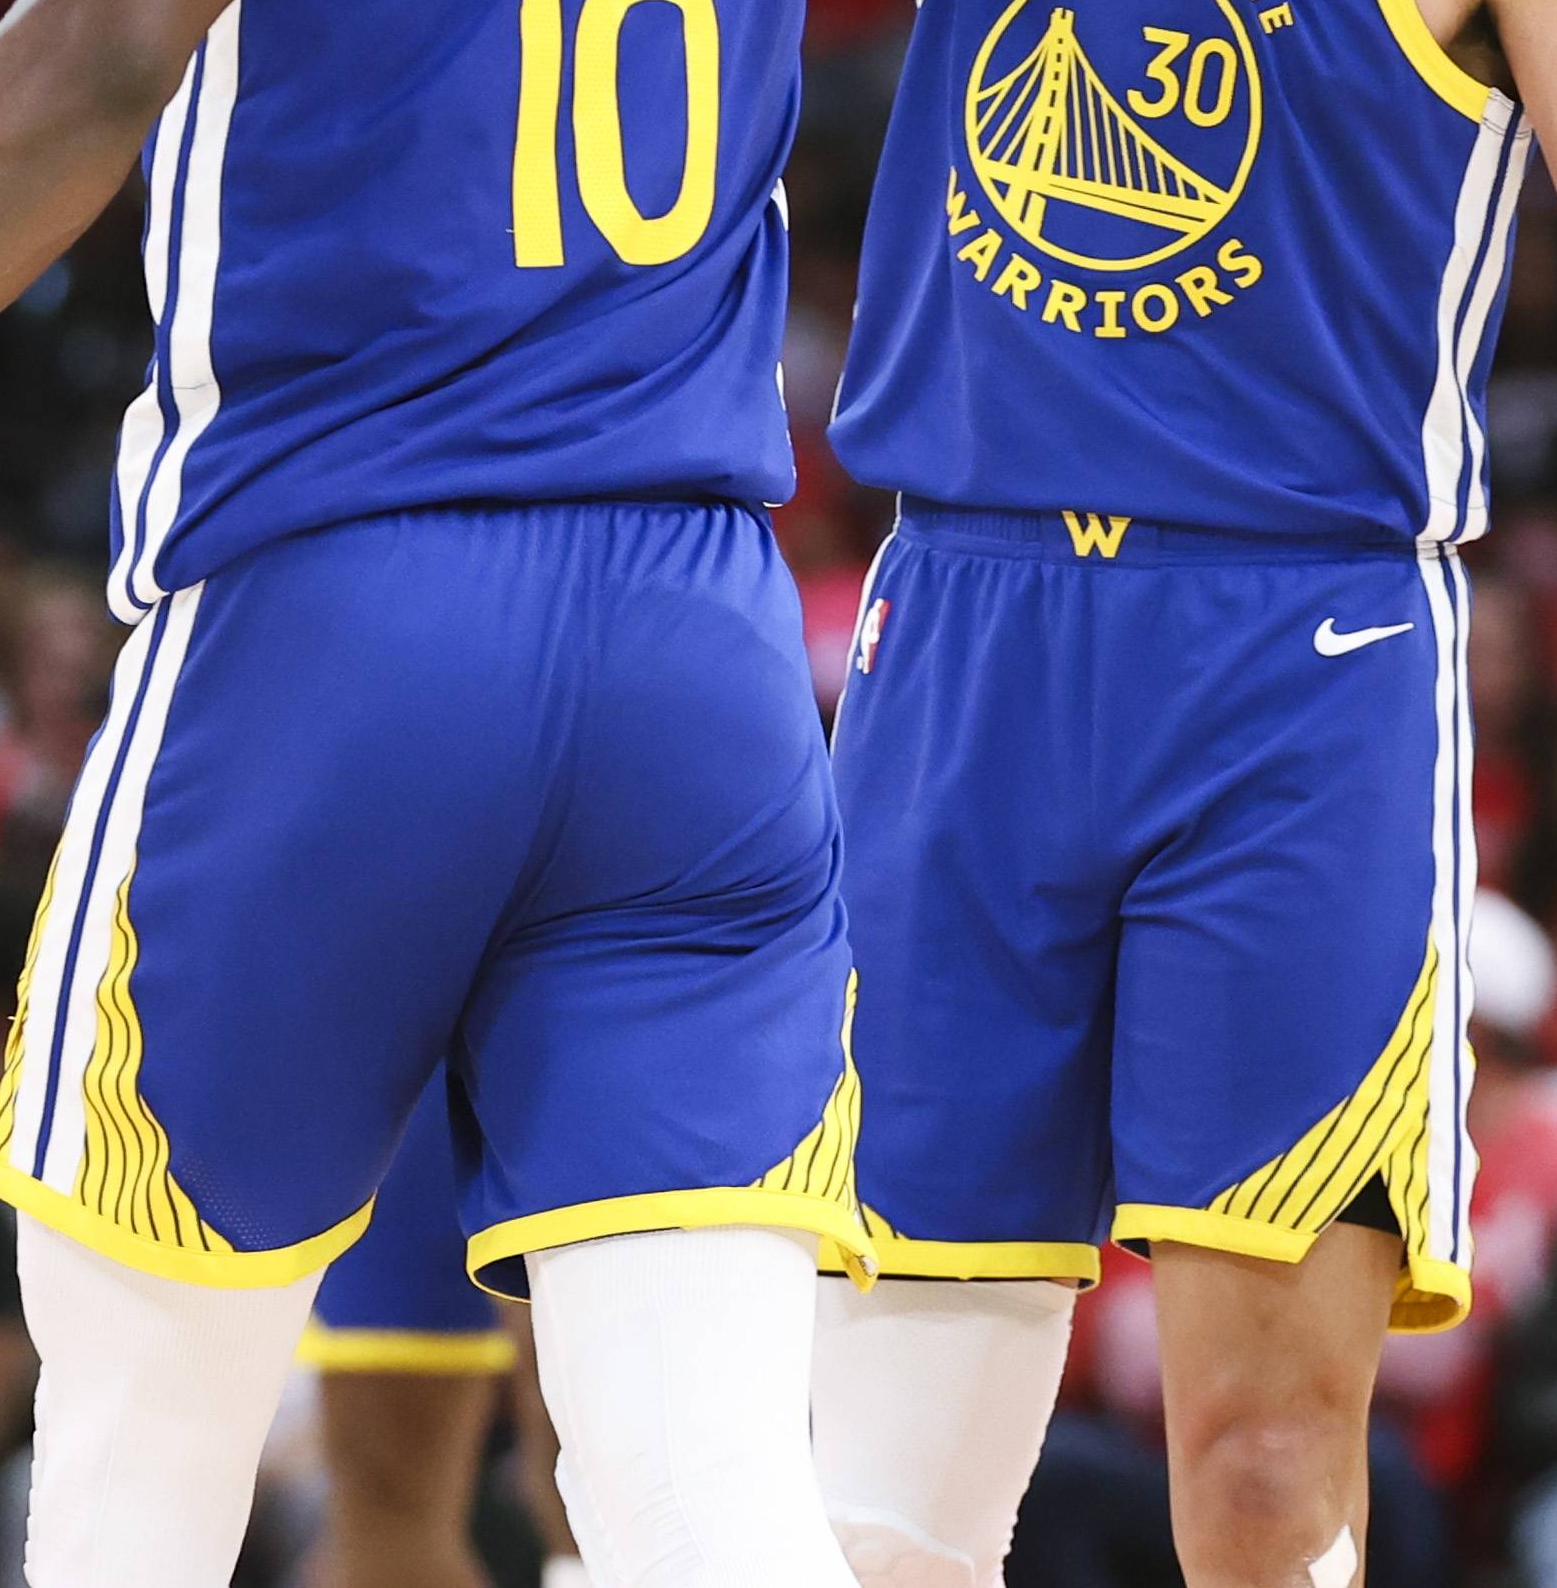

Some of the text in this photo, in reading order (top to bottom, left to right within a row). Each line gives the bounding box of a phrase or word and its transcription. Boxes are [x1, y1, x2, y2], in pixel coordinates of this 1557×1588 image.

[1126, 26, 1239, 129] 30
[946, 167, 1264, 338] WARRIORS
[1062, 510, 1131, 558] W
